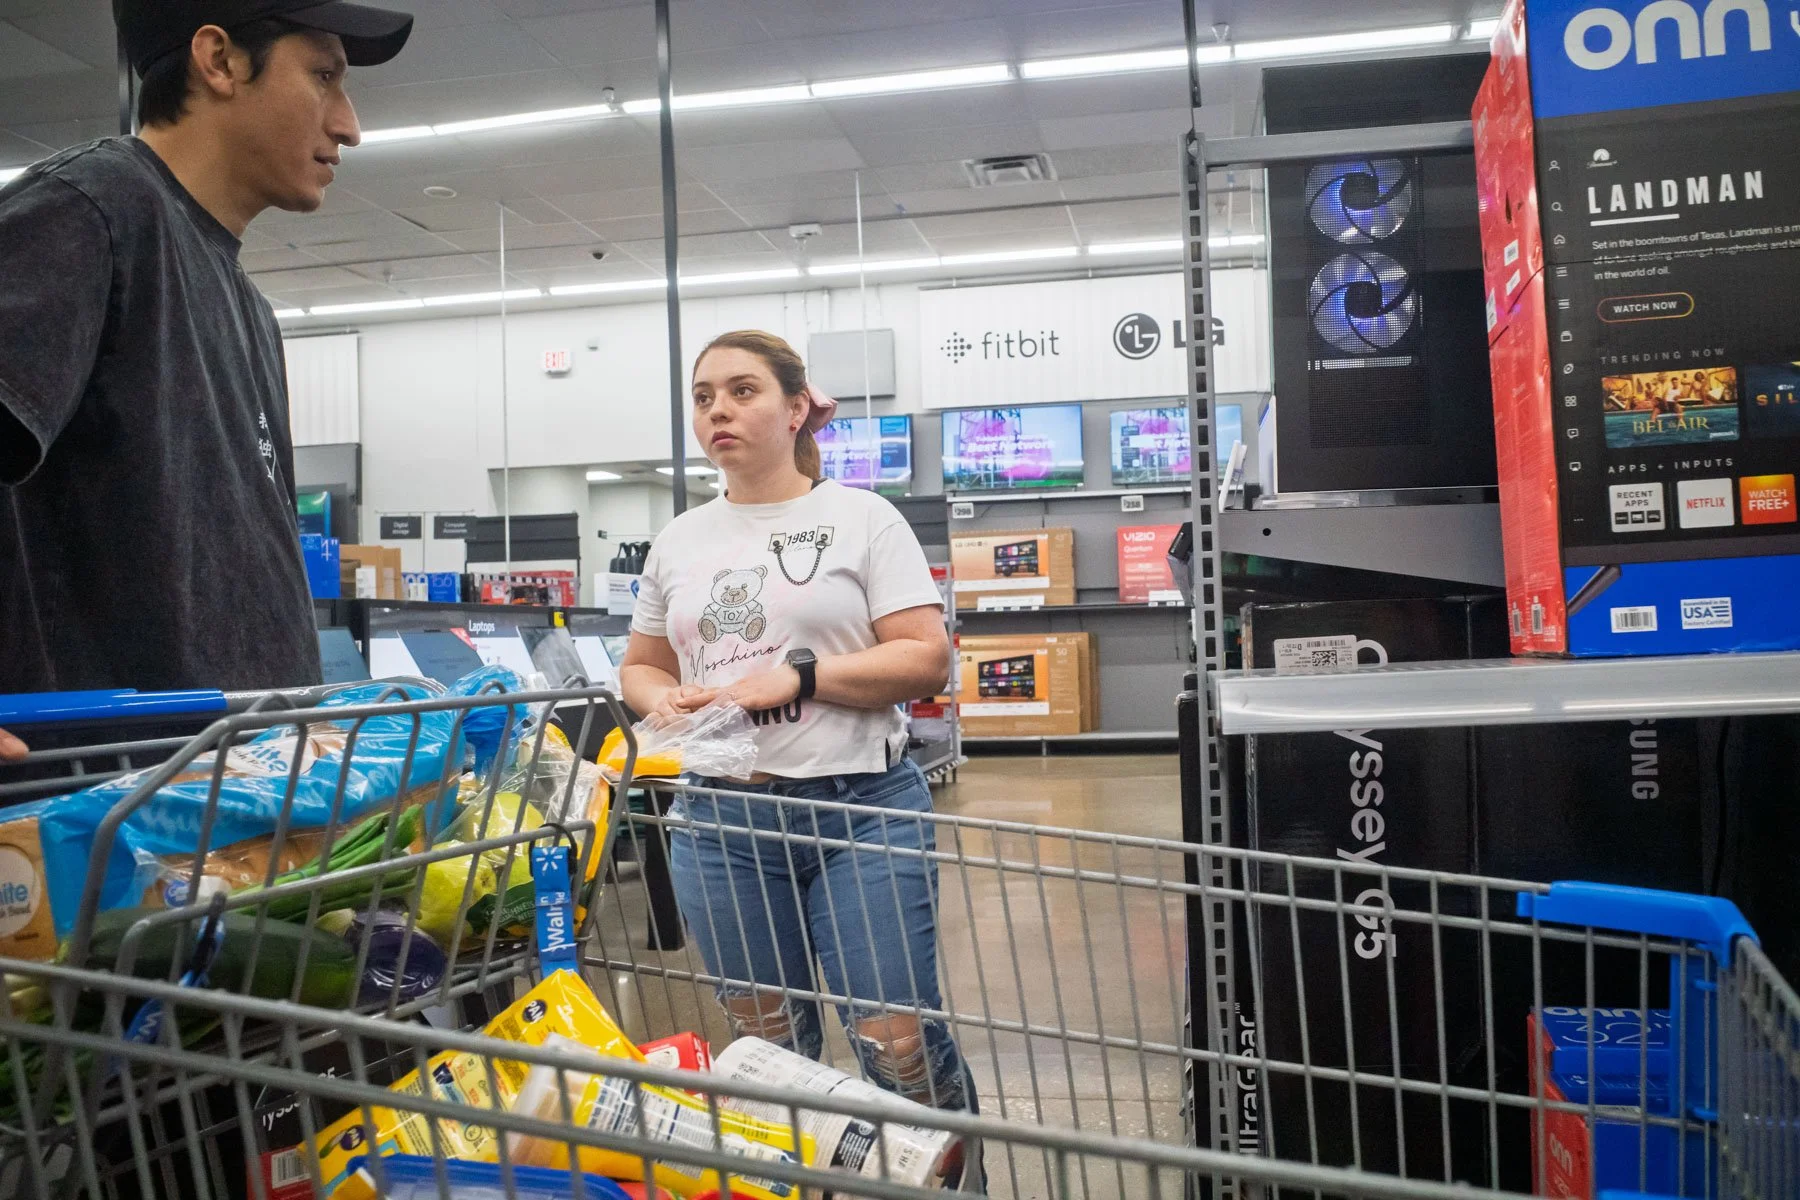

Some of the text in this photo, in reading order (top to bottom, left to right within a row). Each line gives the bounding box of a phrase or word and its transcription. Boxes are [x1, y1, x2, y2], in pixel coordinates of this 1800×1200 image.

[1564, 0, 1771, 70] onn
[1588, 171, 1763, 214] LANDMAN
[1592, 241, 1607, 250] Set
[1609, 240, 1617, 248] in
[1619, 238, 1633, 247] the
[1635, 235, 1688, 246] boomtowns
[1689, 232, 1699, 241] of
[1730, 226, 1772, 238] Landman
[1774, 225, 1782, 234] is
[1594, 272, 1603, 280] in
[1604, 270, 1619, 279] the
[1621, 268, 1645, 278] world
[1646, 267, 1656, 276] of
[1613, 301, 1677, 313] WATCH NOW
[982, 330, 1060, 360] fitbit
[1601, 348, 1726, 365] TRENDING NOW
[1608, 464, 1648, 474] APPS
[1675, 458, 1734, 470] INPUTS
[1617, 490, 1653, 499] RECENT
[1749, 488, 1787, 498] WATCH
[1625, 499, 1649, 507] APPS
[1687, 497, 1726, 509] NETFLIX
[1749, 499, 1790, 511] FREE+
[787, 530, 815, 546] 1983
[1123, 532, 1156, 542] VIZIO
[723, 609, 744, 622] TOY
[1683, 607, 1714, 619] USA
[469, 620, 495, 635] Laptops
[690, 643, 782, 685] Moschino
